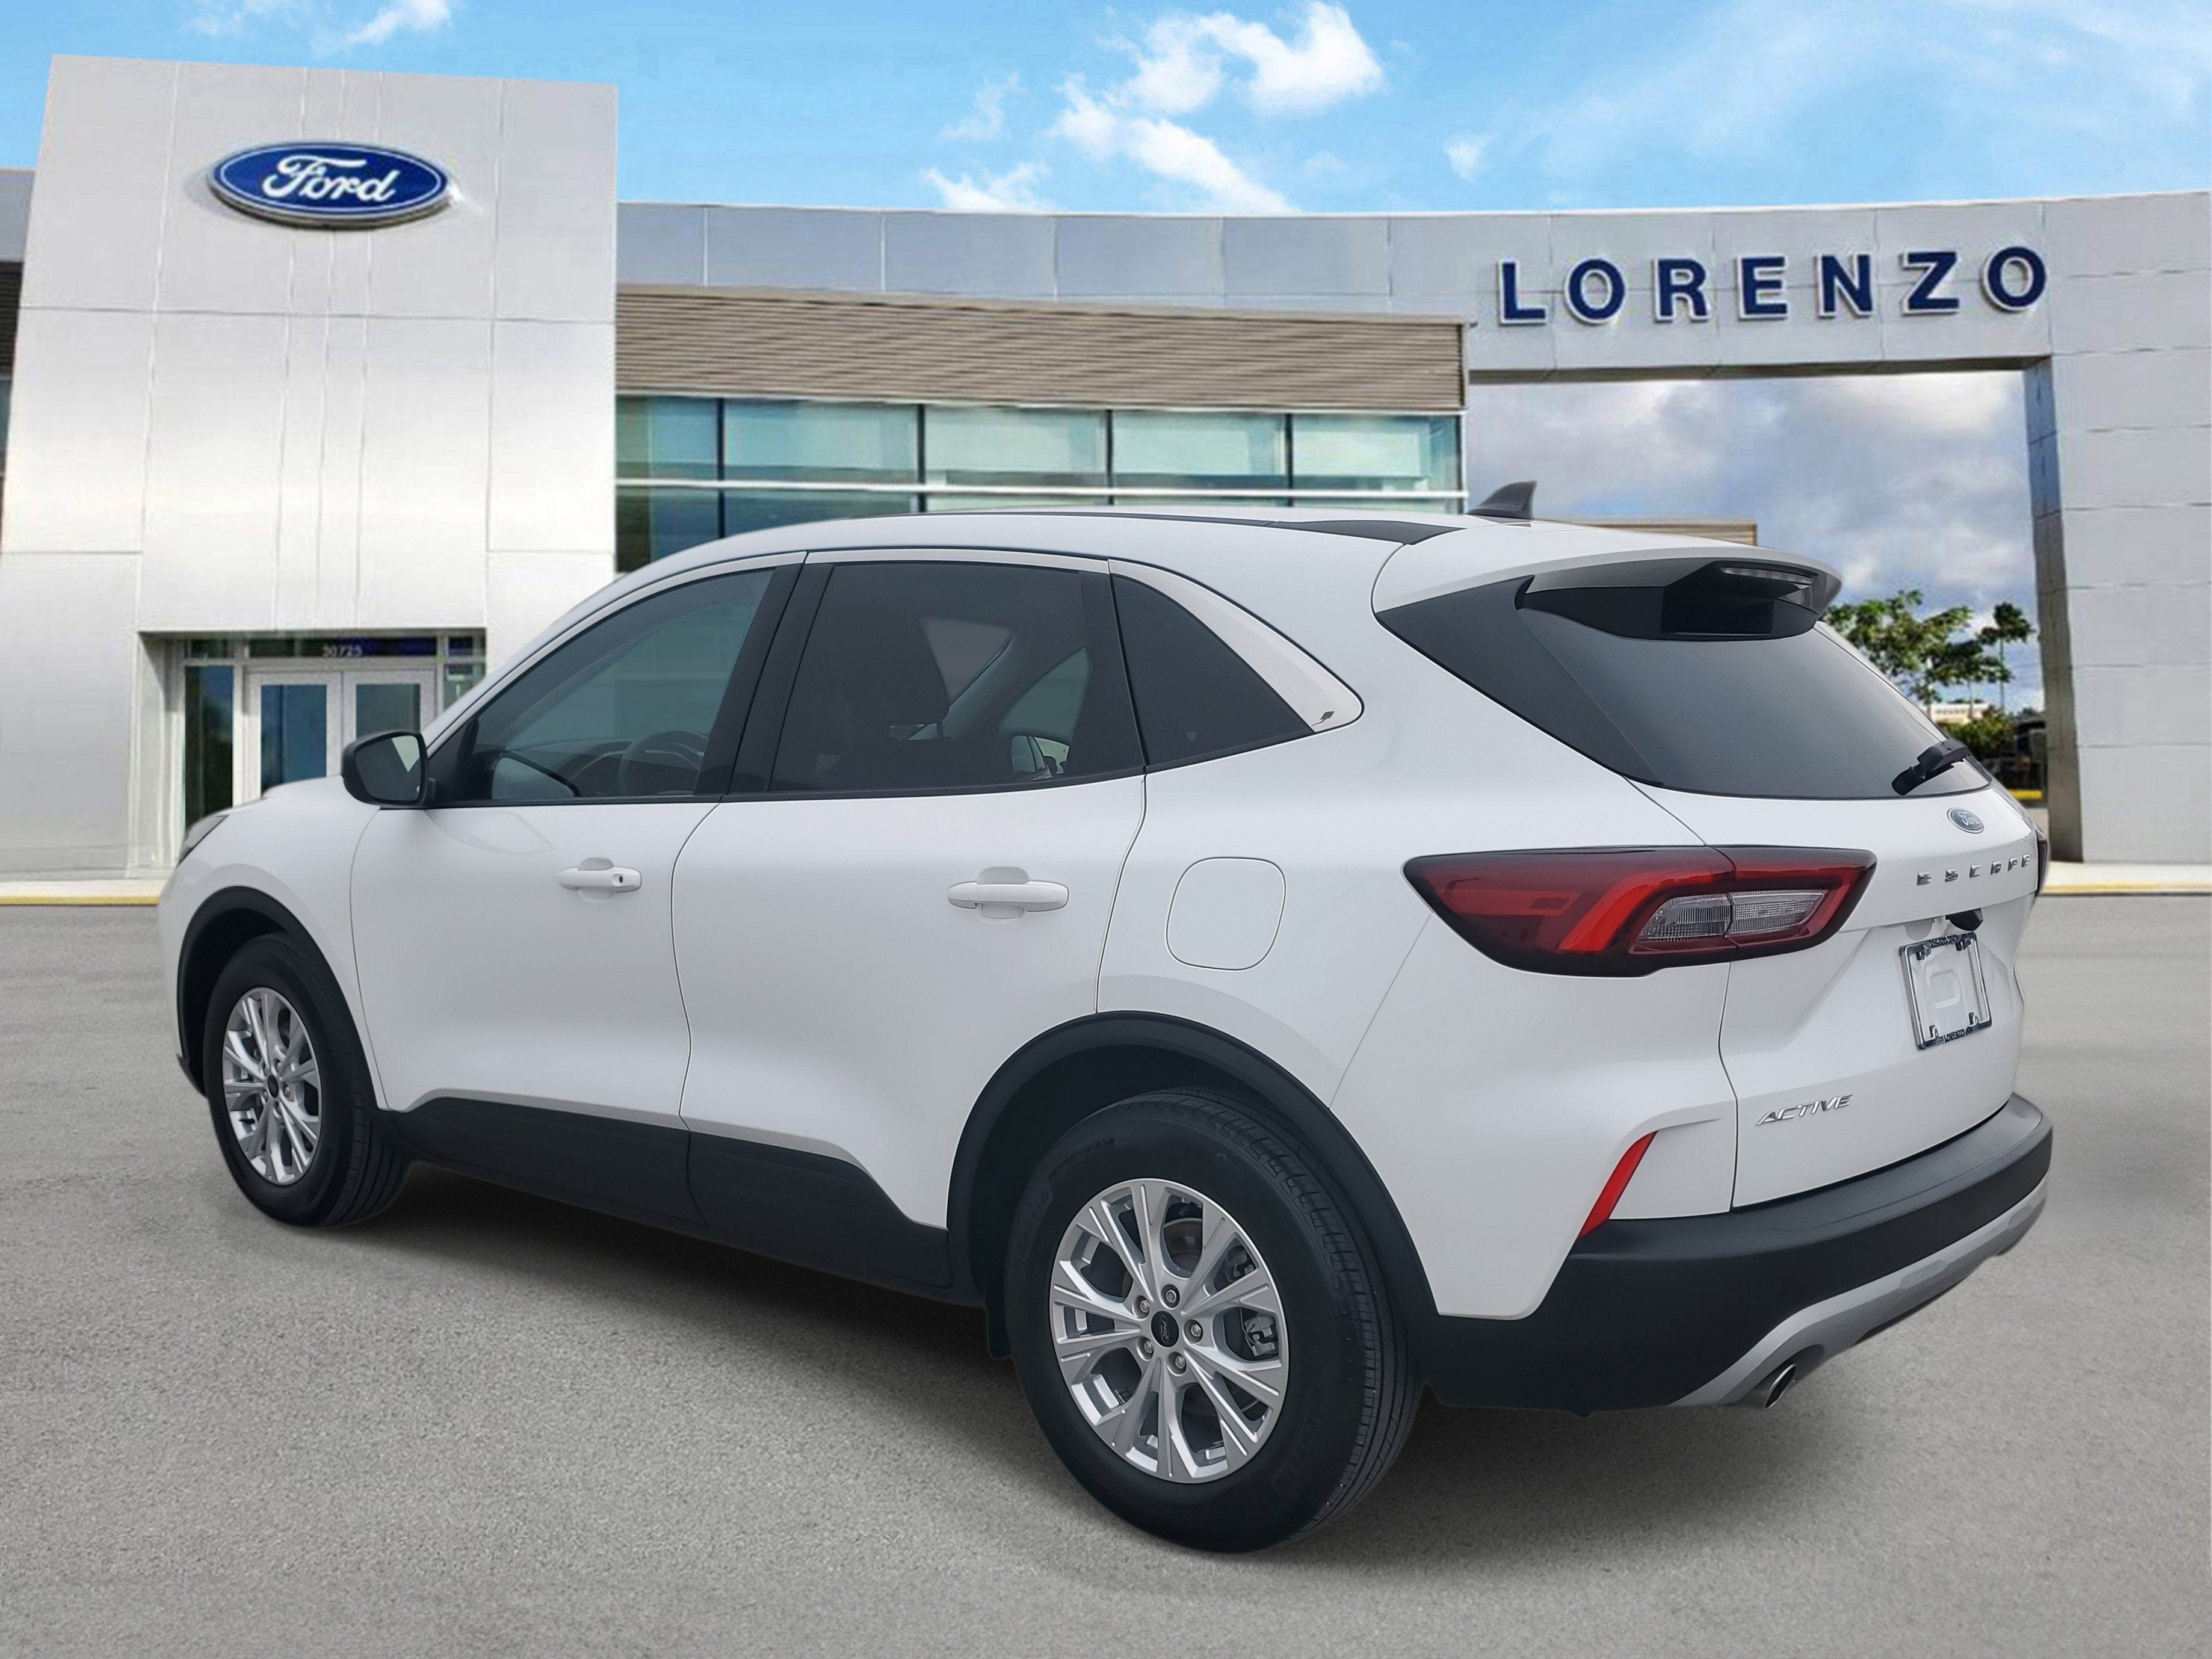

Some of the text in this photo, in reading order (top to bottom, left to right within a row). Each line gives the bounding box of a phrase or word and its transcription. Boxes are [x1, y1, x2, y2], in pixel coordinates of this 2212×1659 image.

[262, 155, 400, 201] Ford
[1497, 246, 2047, 325] LORENZO
[1917, 854, 2030, 886] ESCAPE
[1754, 1094, 1853, 1126] ACTIVE
